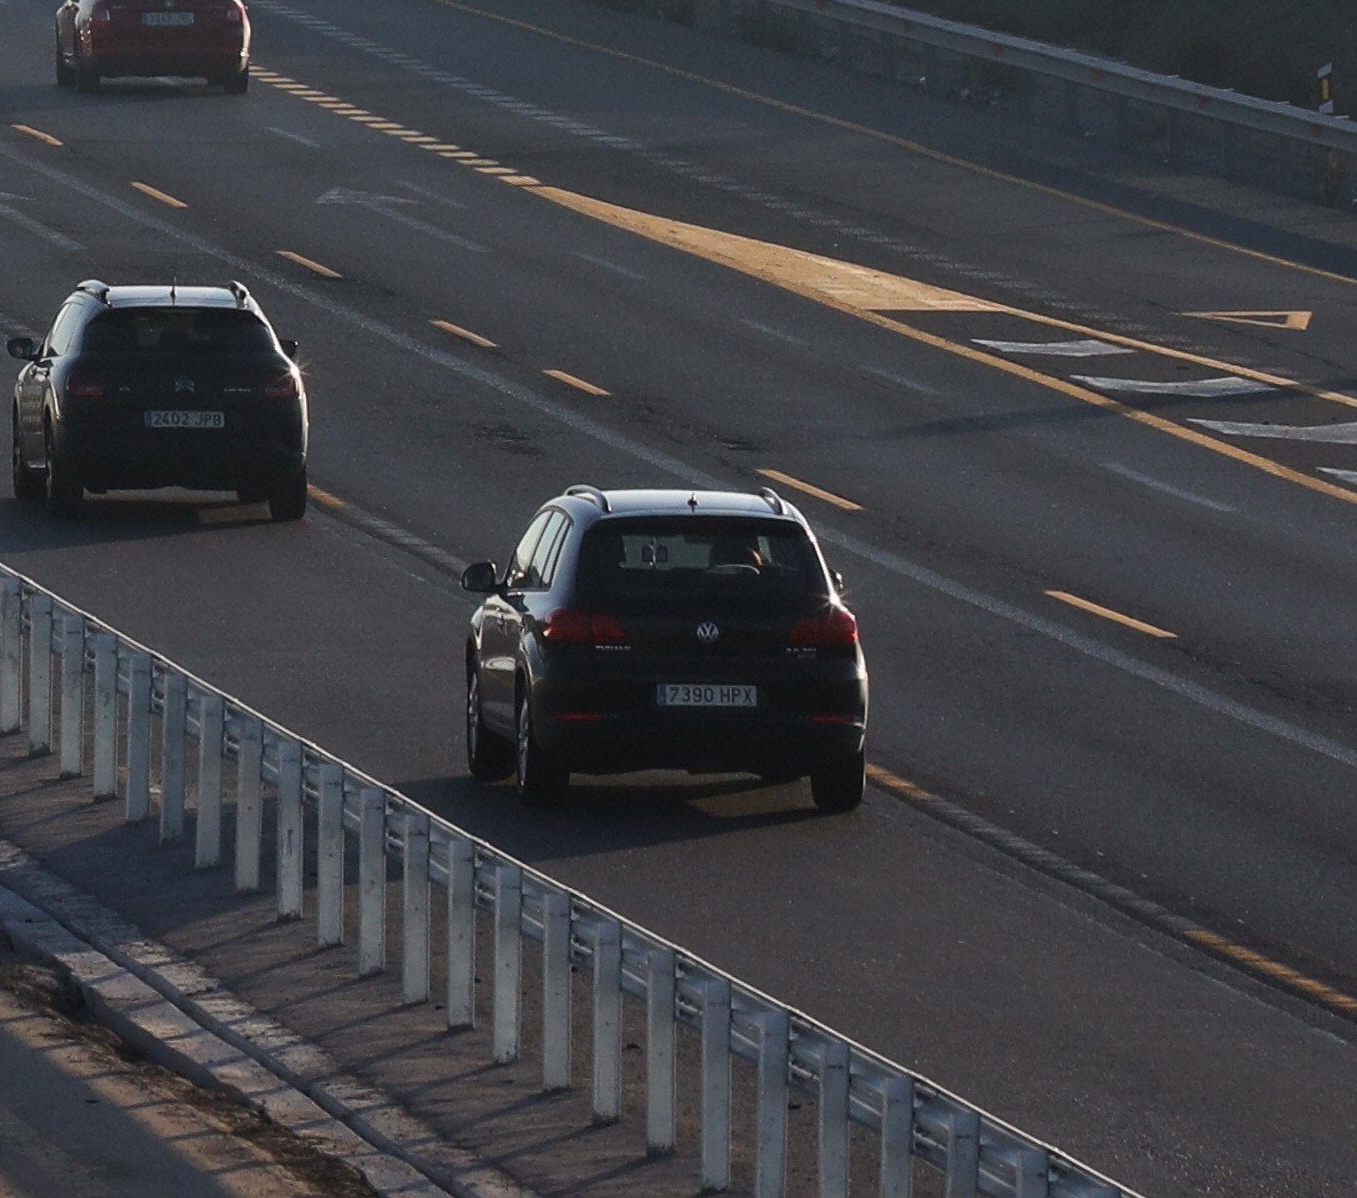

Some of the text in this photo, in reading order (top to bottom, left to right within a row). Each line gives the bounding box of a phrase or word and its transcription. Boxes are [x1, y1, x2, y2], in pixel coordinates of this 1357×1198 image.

[153, 412, 223, 427] 2402 JPB
[669, 687, 756, 703] 7390 HPX
